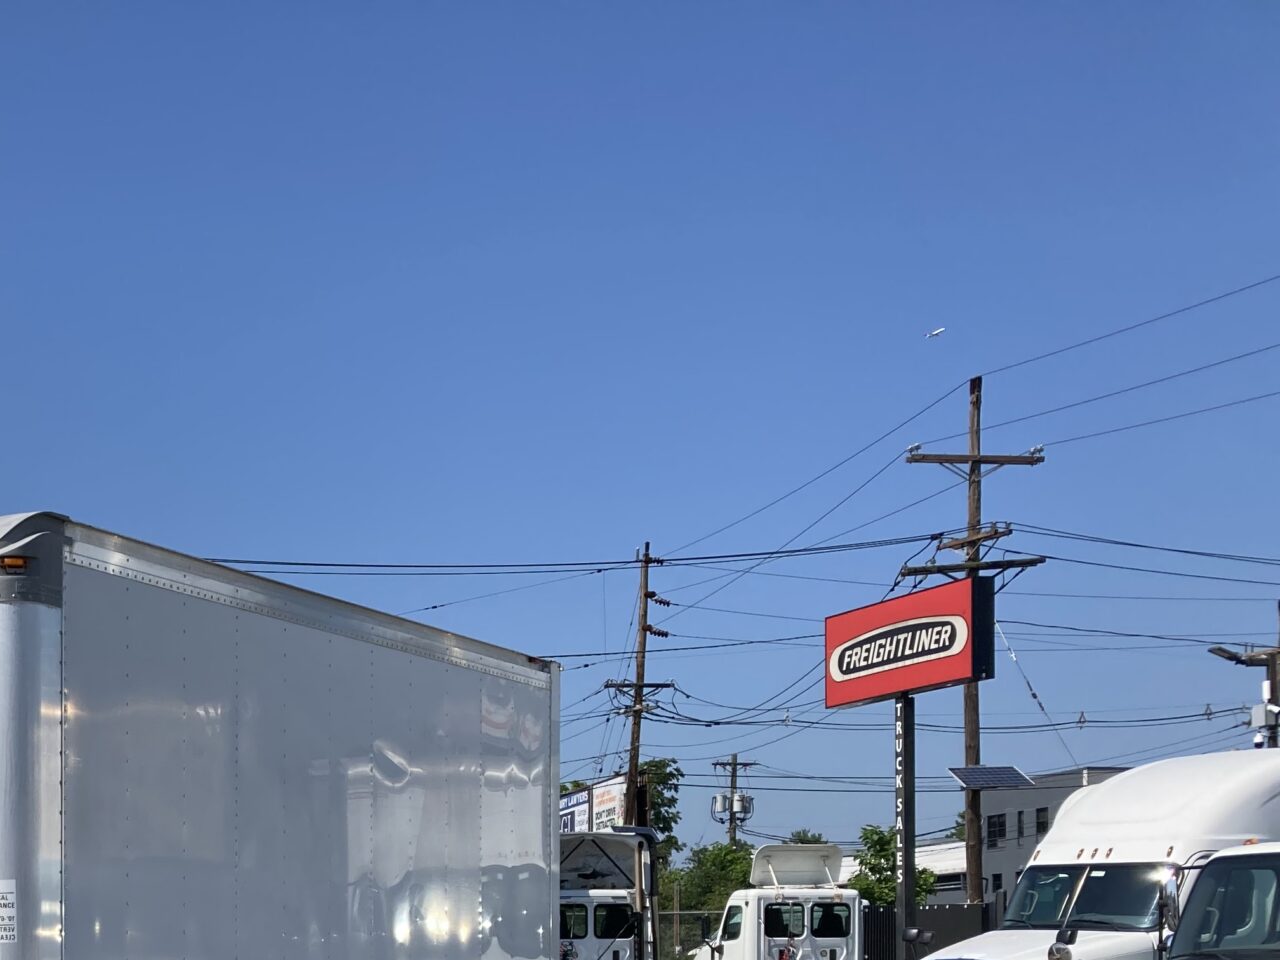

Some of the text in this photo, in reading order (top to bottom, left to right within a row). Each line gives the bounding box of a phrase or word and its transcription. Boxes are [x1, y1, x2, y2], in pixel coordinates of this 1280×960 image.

[842, 624, 952, 671] FREIGHTLINER
[895, 702, 903, 883] TRUCK SALES
